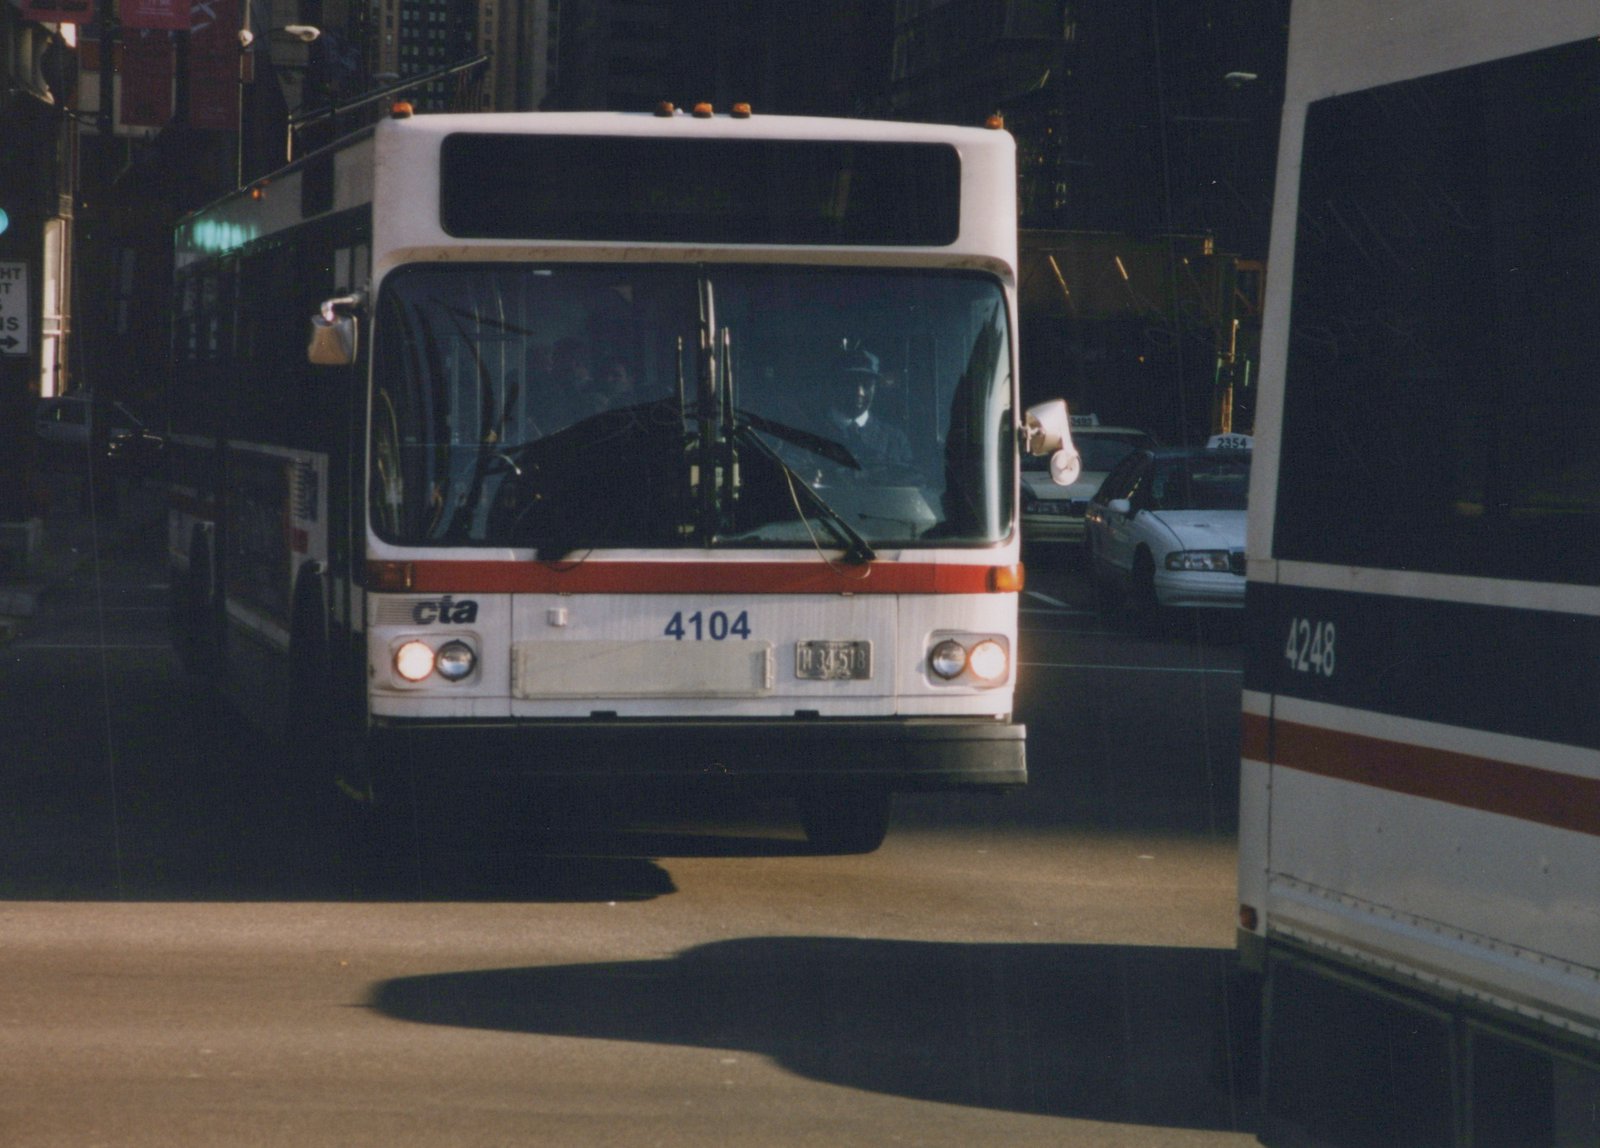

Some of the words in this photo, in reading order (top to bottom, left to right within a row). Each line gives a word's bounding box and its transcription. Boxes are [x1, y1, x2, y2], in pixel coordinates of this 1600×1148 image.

[1217, 437, 1247, 449] 2354
[413, 595, 478, 624] cta
[665, 611, 751, 640] 4104
[1284, 616, 1337, 679] 4248
